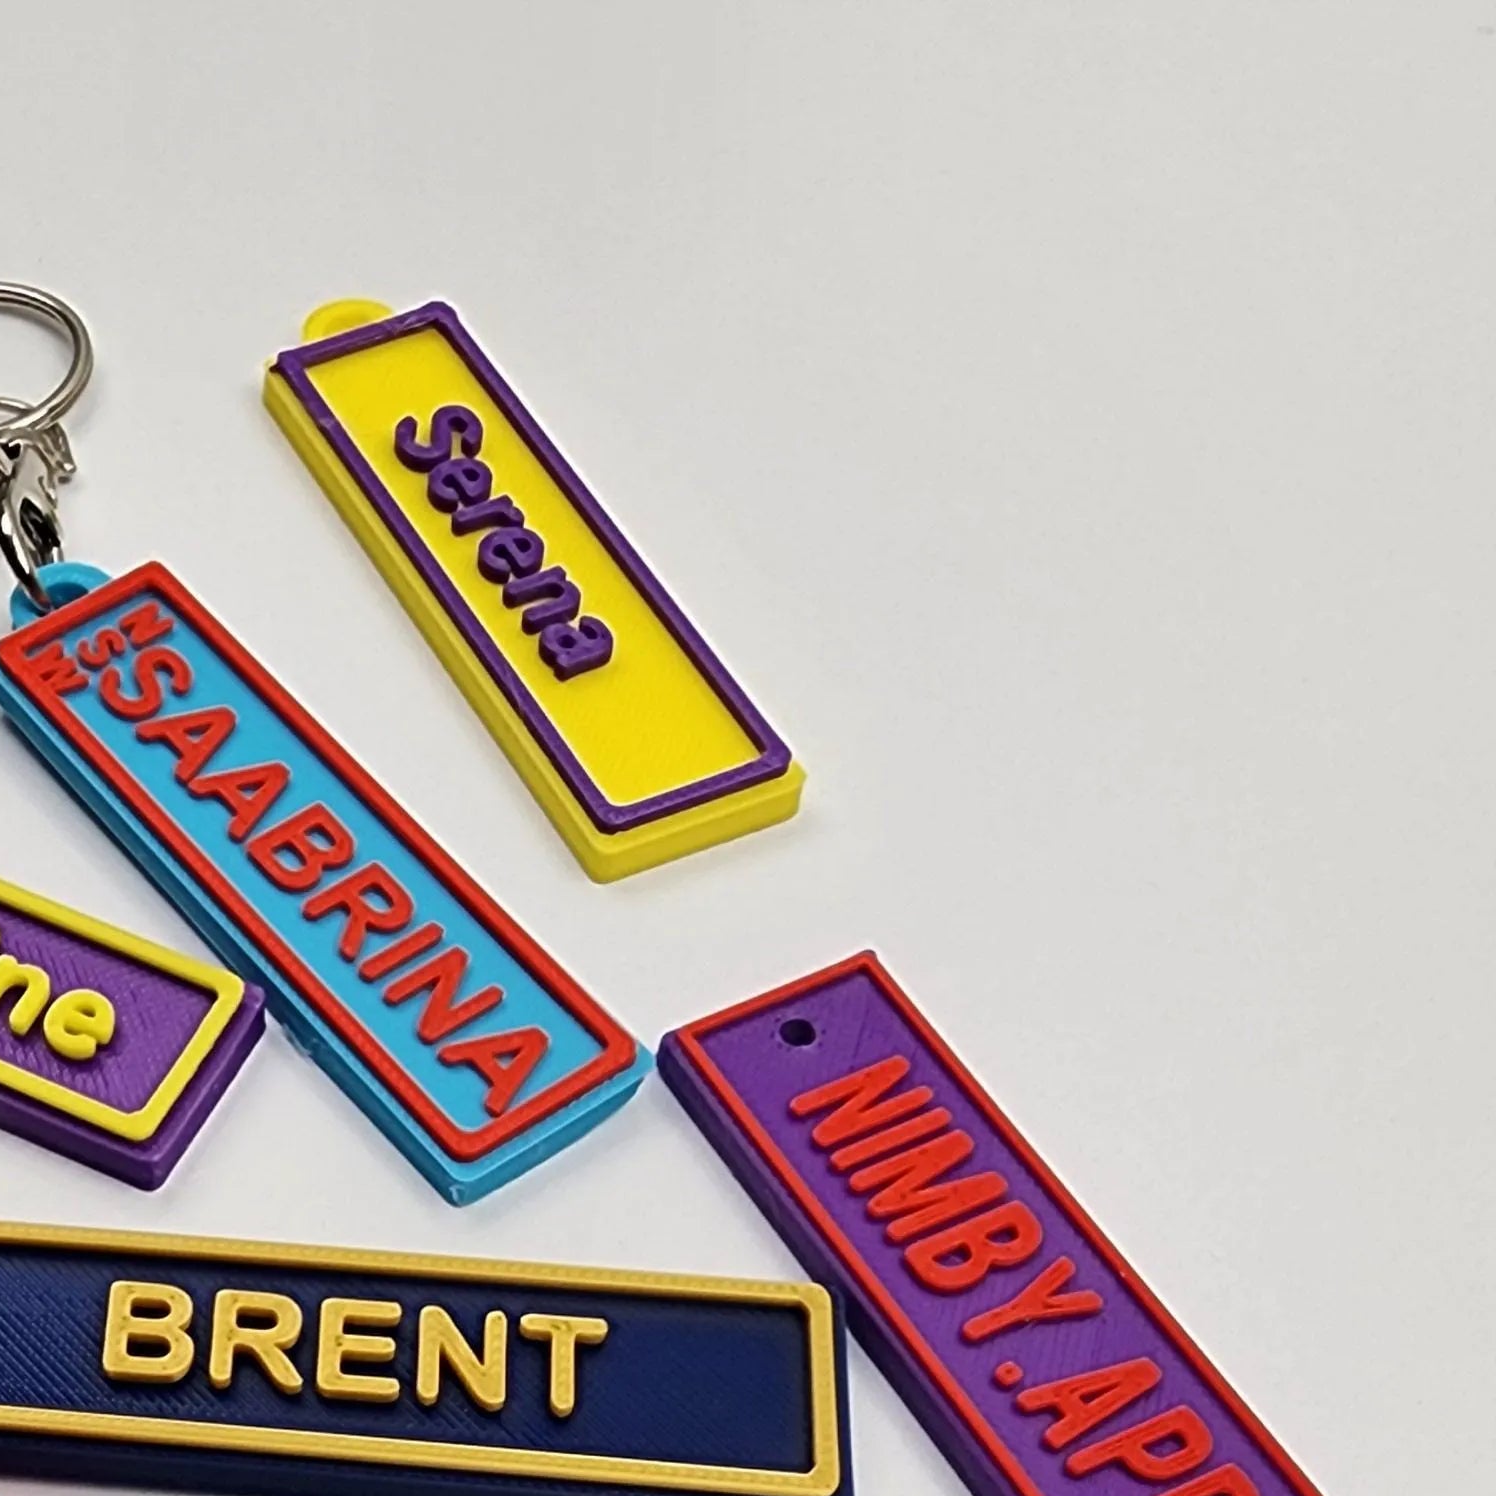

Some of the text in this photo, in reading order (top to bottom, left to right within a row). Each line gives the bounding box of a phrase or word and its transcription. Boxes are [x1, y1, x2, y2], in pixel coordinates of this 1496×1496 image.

[395, 406, 614, 681] Serena
[99, 646, 548, 1115] SAABRINA
[104, 1280, 608, 1417] BRENT
